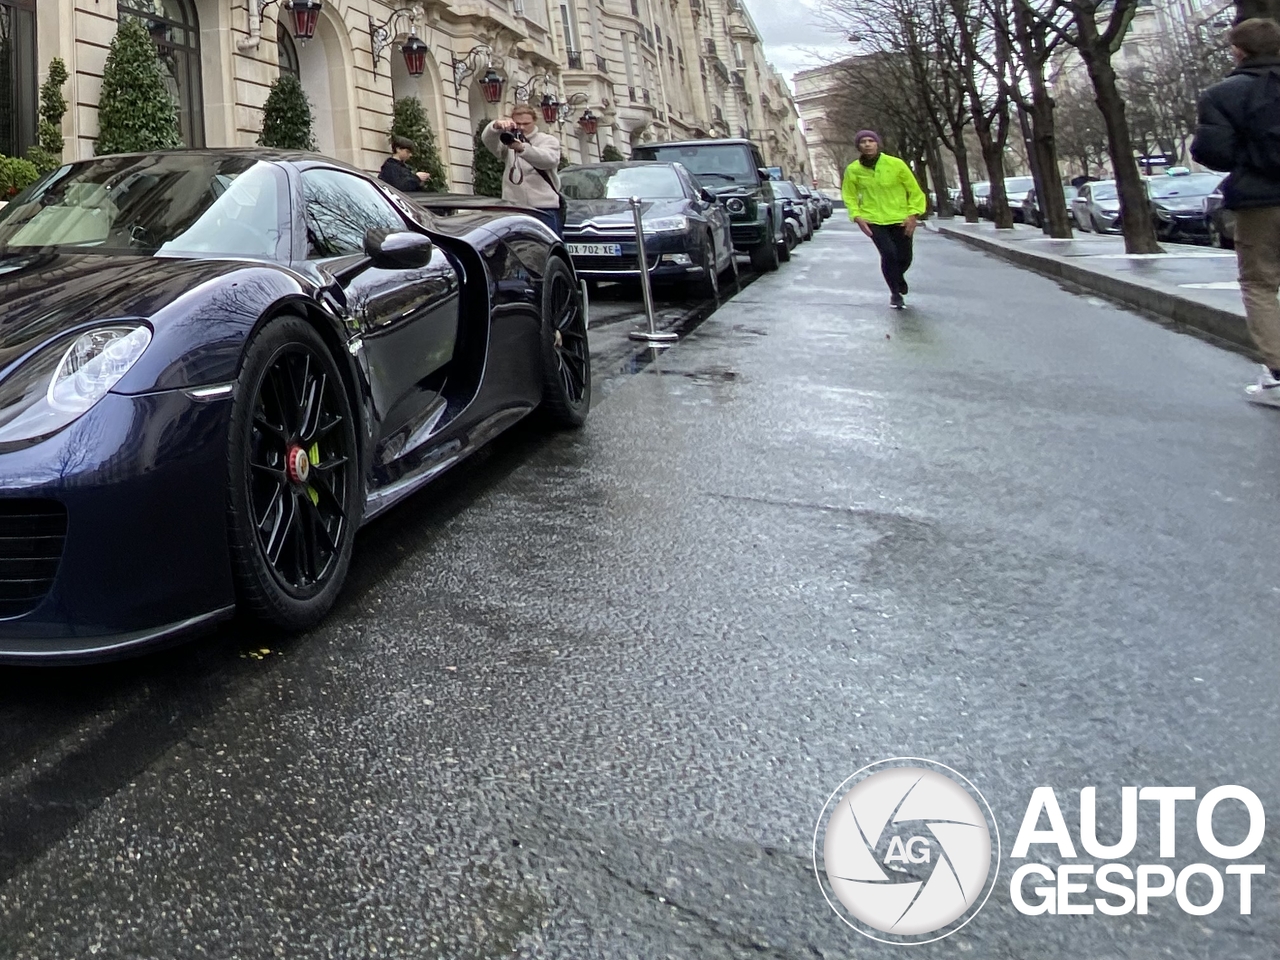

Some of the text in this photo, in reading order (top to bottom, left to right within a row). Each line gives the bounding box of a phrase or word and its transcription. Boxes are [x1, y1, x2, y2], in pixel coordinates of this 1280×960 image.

[568, 245, 615, 255] DX 702 XE
